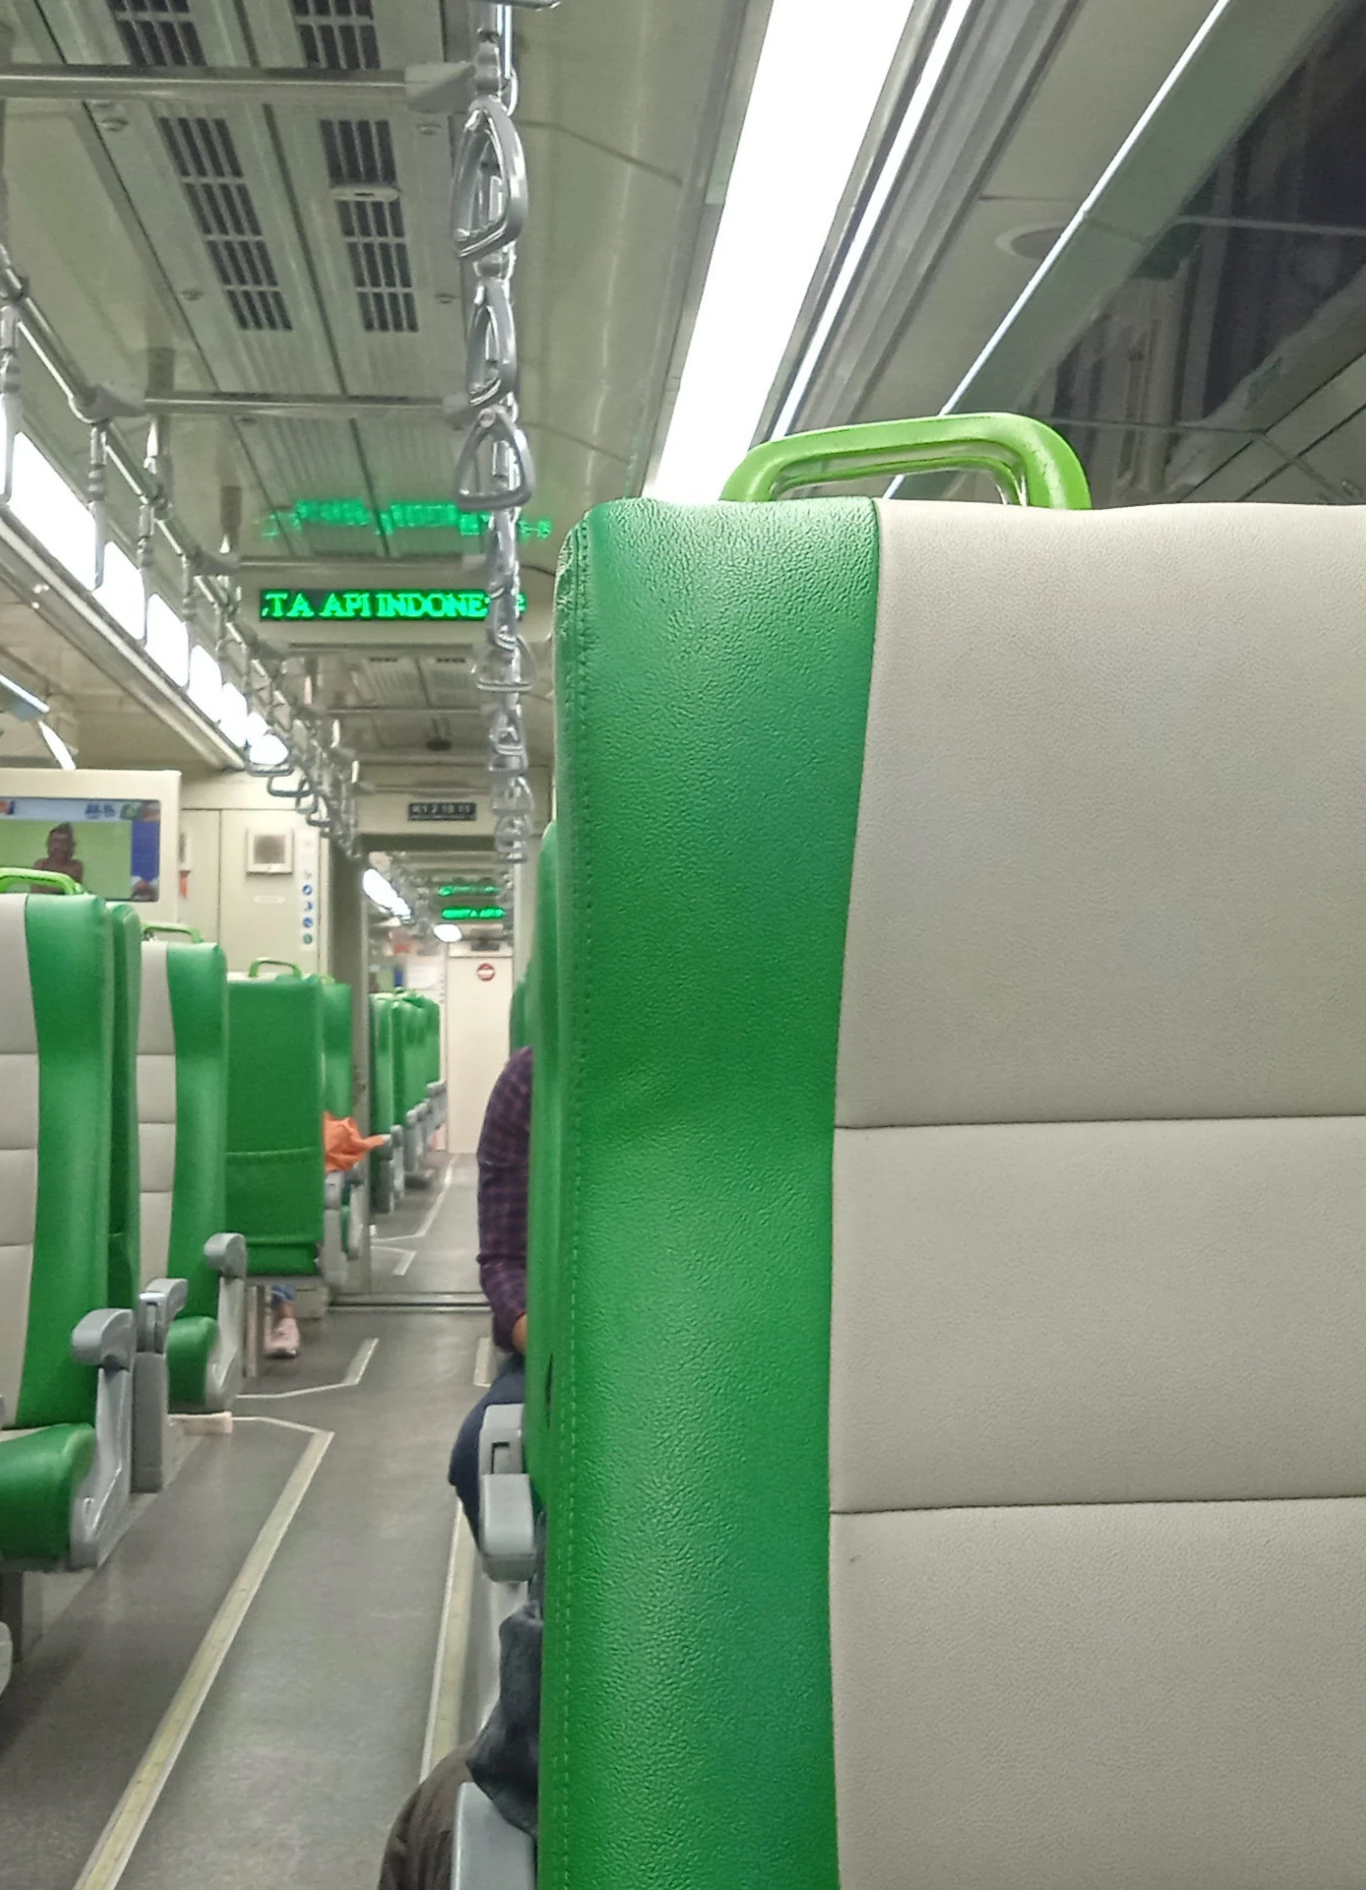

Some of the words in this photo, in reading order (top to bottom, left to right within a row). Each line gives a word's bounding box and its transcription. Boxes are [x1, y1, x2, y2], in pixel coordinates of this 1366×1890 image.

[261, 593, 314, 617] TA
[319, 593, 371, 617] API
[376, 593, 526, 617] INDONE
